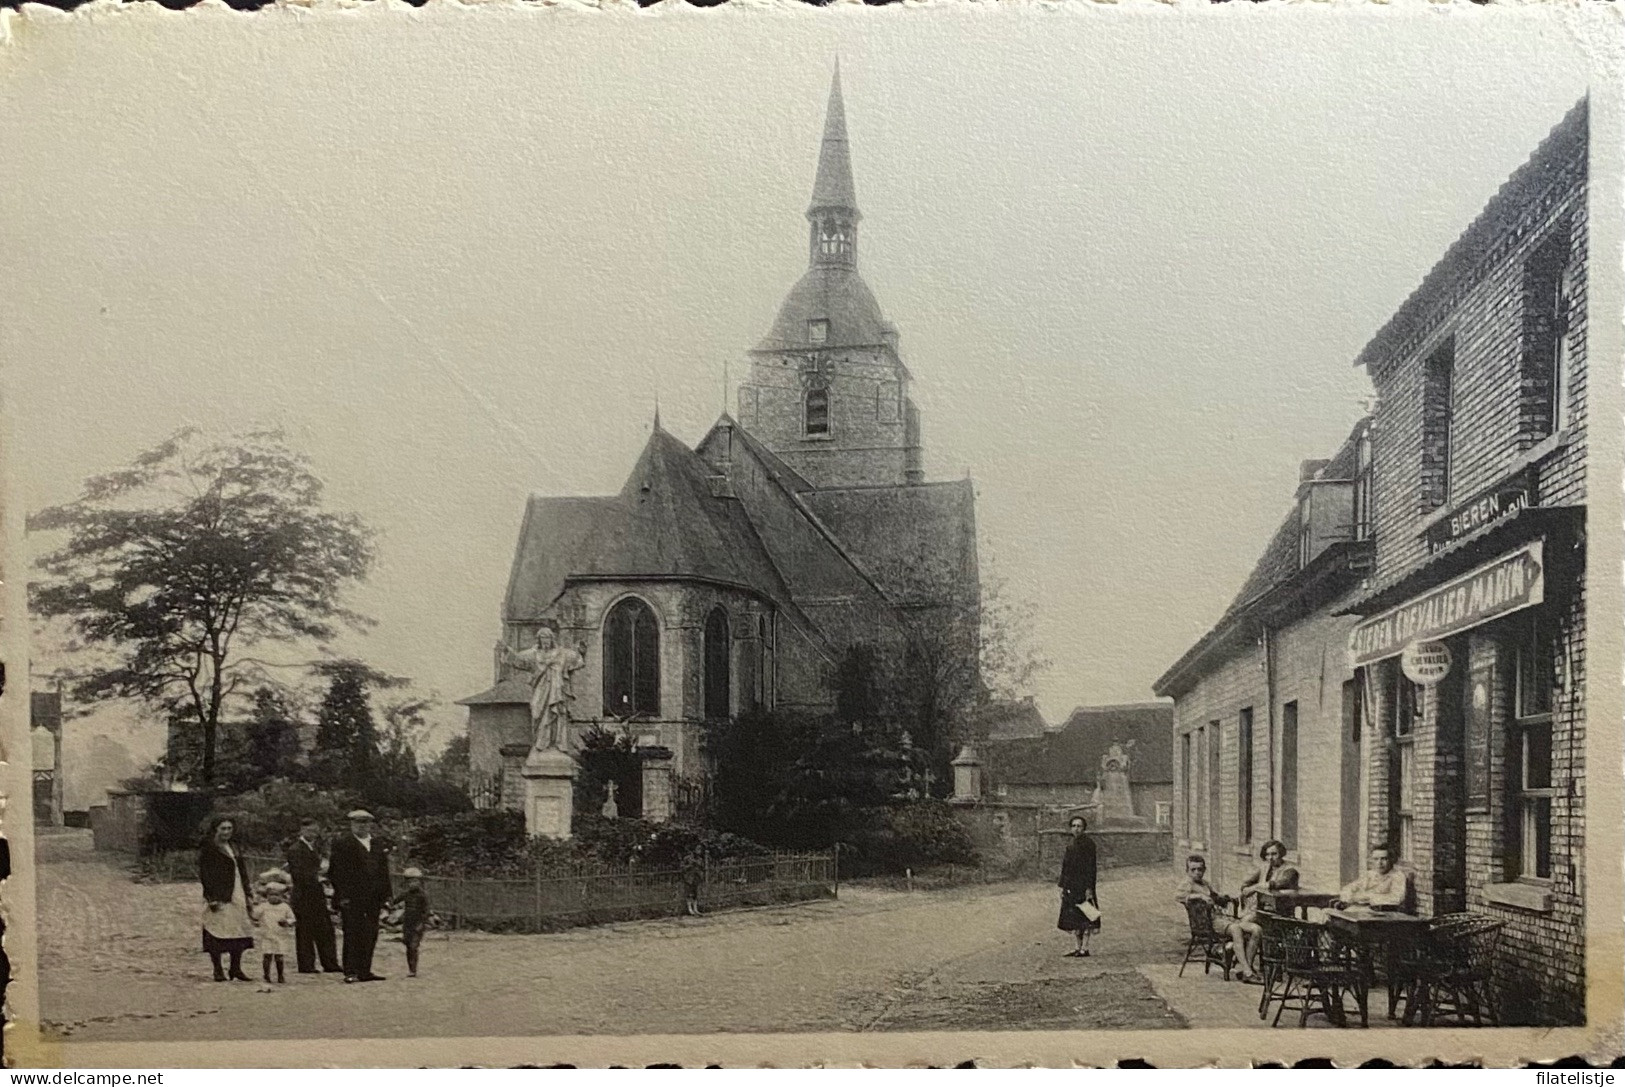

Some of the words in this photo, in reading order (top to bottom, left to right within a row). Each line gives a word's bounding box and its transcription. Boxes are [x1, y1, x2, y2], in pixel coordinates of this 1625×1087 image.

[1451, 493, 1499, 536] BIEREN
[1396, 587, 1466, 642] CHEVALIER
[1467, 558, 1524, 611] MARIN
